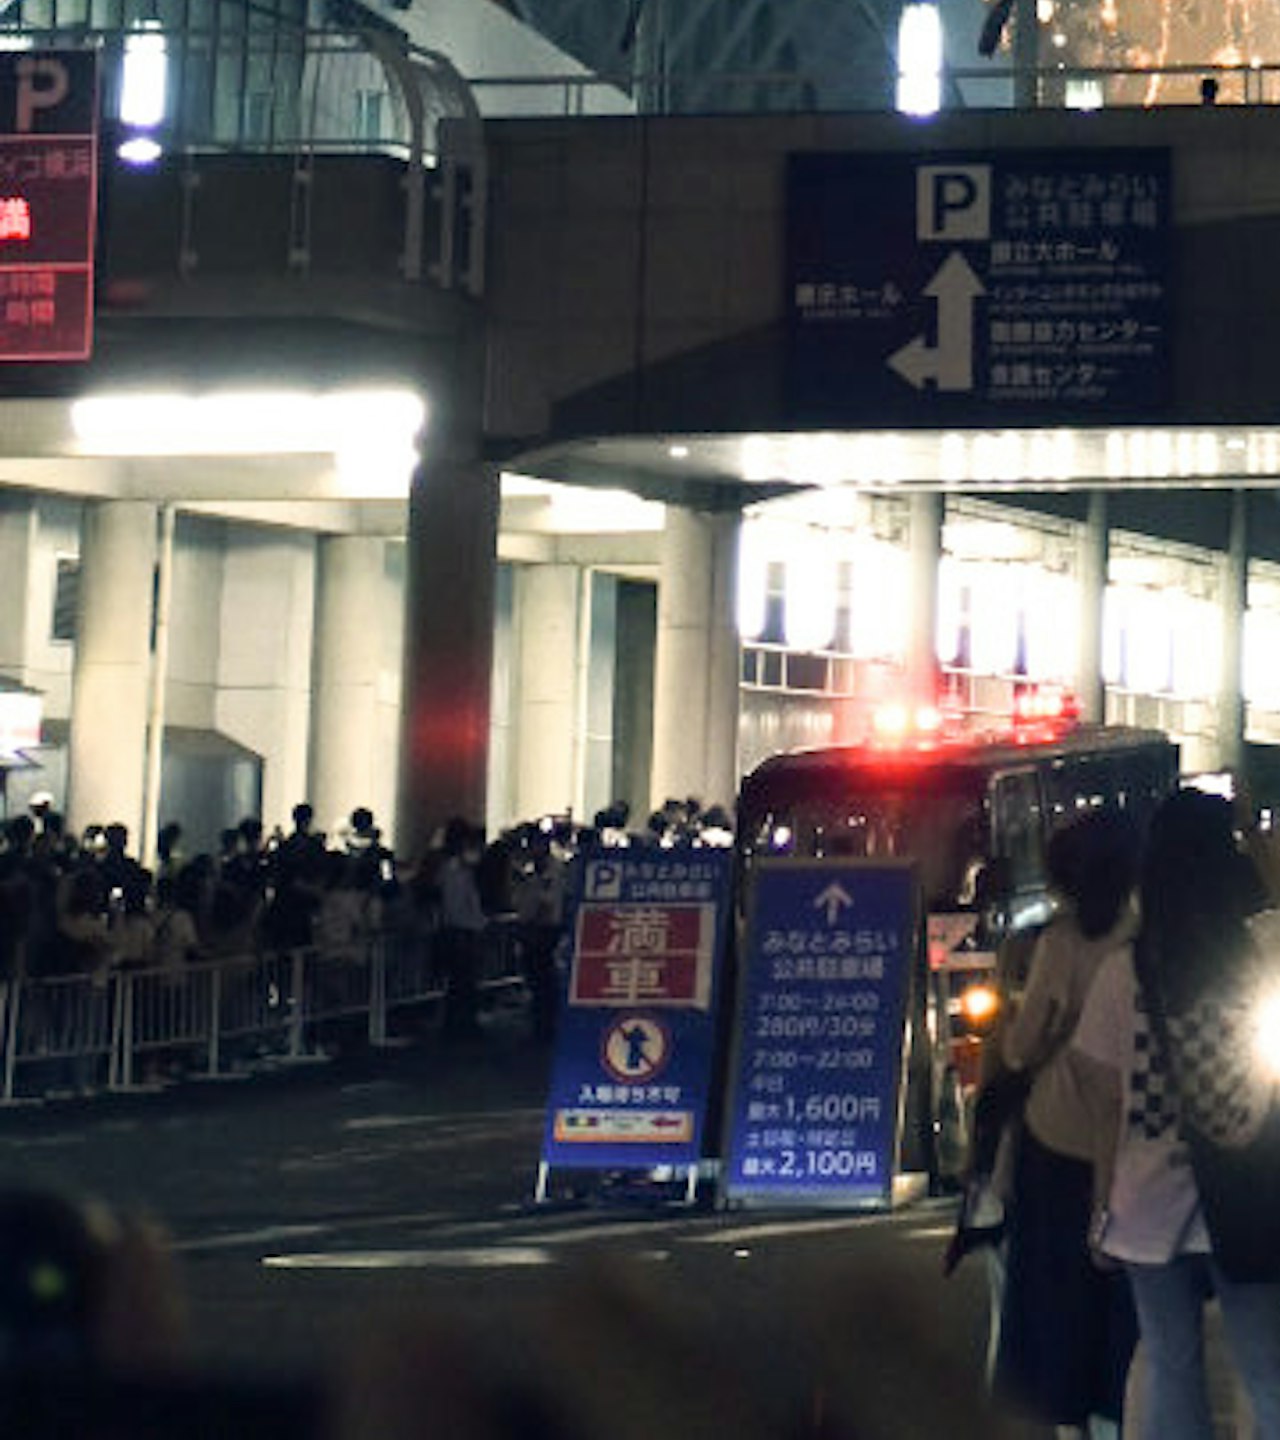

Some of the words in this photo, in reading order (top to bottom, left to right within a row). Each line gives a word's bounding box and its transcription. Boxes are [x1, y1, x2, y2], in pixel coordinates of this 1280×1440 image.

[16, 58, 70, 133] P
[933, 173, 978, 233] P
[594, 865, 617, 893] P
[763, 930, 899, 954] みなとみらい
[772, 957, 884, 980] 公共駐車場
